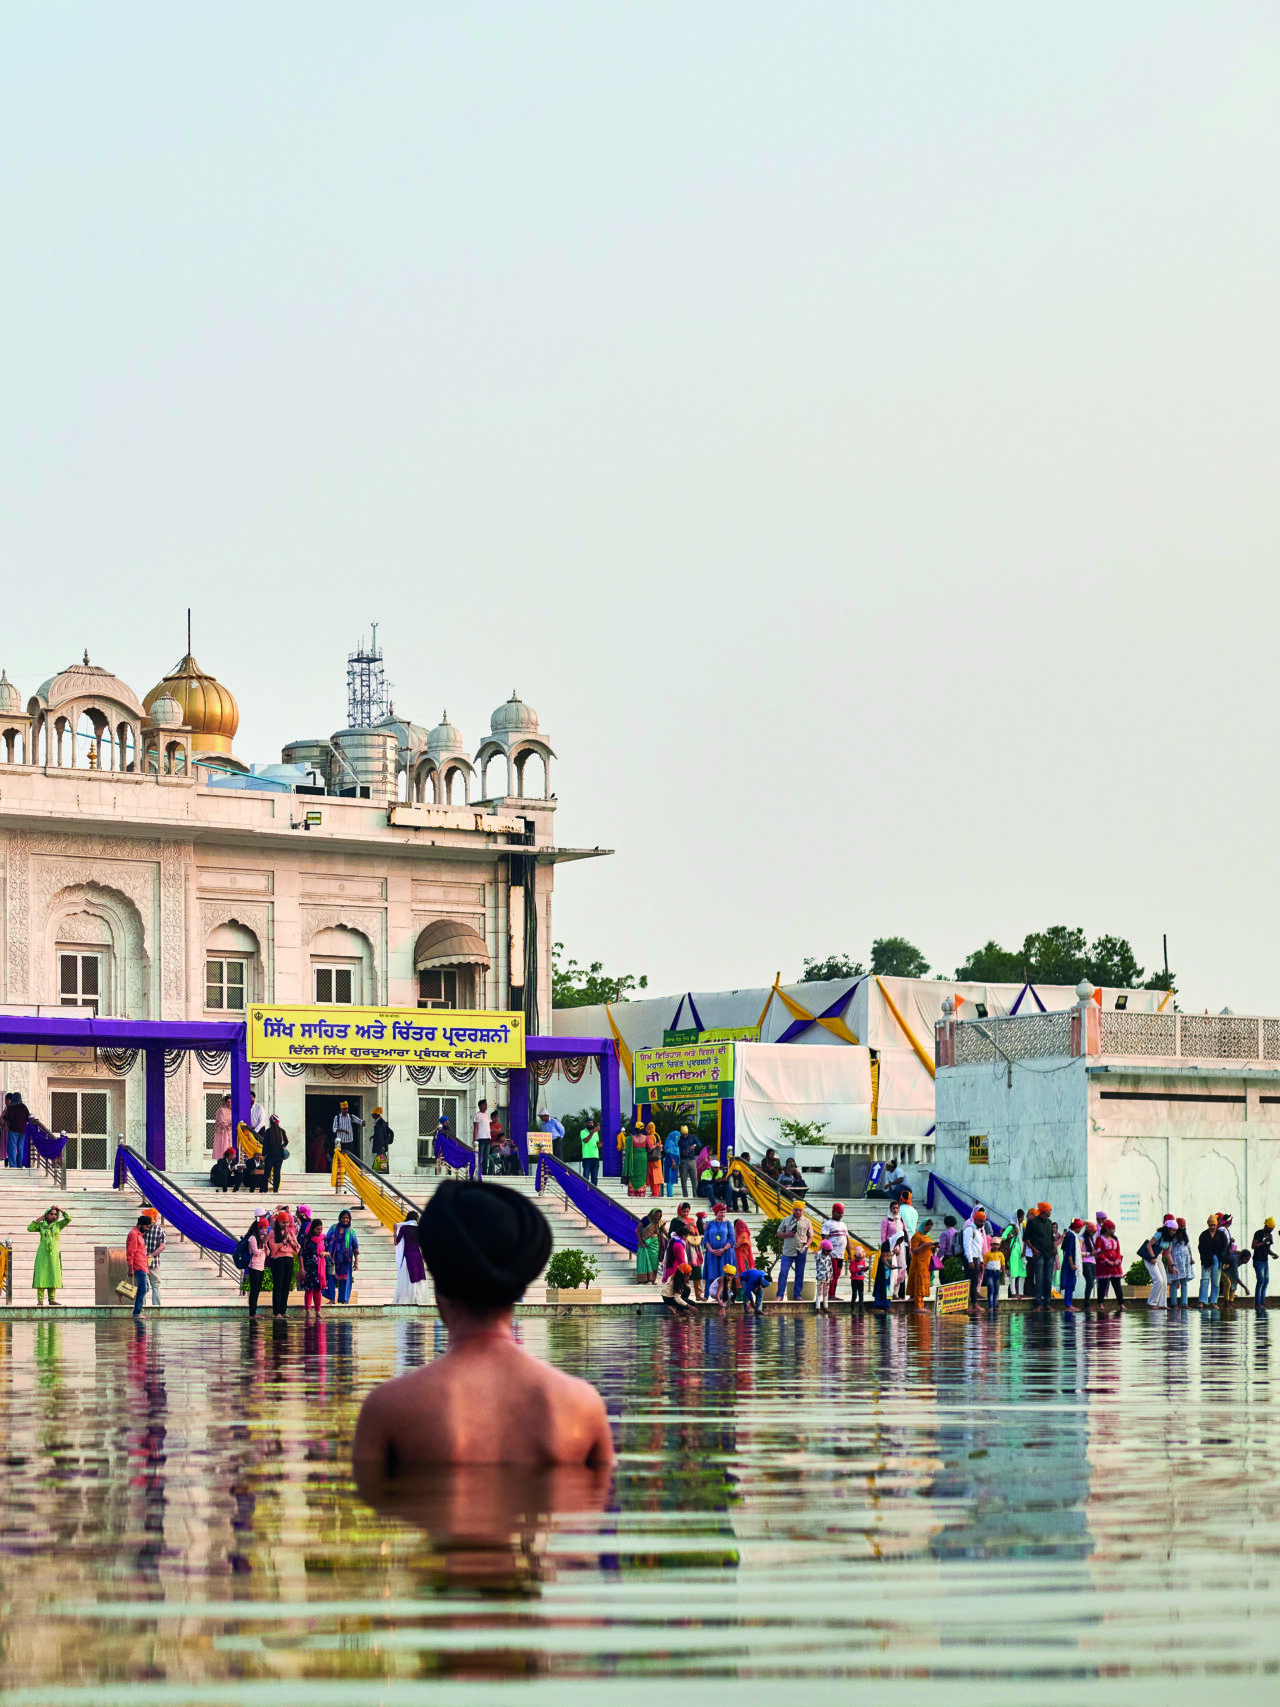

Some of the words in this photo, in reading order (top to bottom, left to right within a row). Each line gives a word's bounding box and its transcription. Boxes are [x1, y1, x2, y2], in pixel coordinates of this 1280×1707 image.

[264, 1017, 296, 1038] ਸਿੱਖ
[300, 1018, 350, 1038] ਸਾਹਿਤ
[355, 1020, 387, 1040] ਅਤੇ
[392, 1020, 438, 1041] ਚਿੱਤਰ
[442, 1024, 510, 1047] ਪ੍ਰਦਰਸ਼ਨੀ
[288, 1044, 320, 1056] ਦਿੱਲੀ
[323, 1044, 346, 1056] ਸਿੱਖ
[350, 1048, 410, 1058] ਗੁਰਦੁਆਰਾ
[414, 1048, 451, 1060] ਪ੍ਰਬੰਧਕ
[454, 1049, 488, 1060] ਕਮੇਟੀ
[646, 1071, 660, 1082] ਜੀ
[711, 1066, 720, 1080] ਨੂੰ
[969, 1136, 980, 1147] NO
